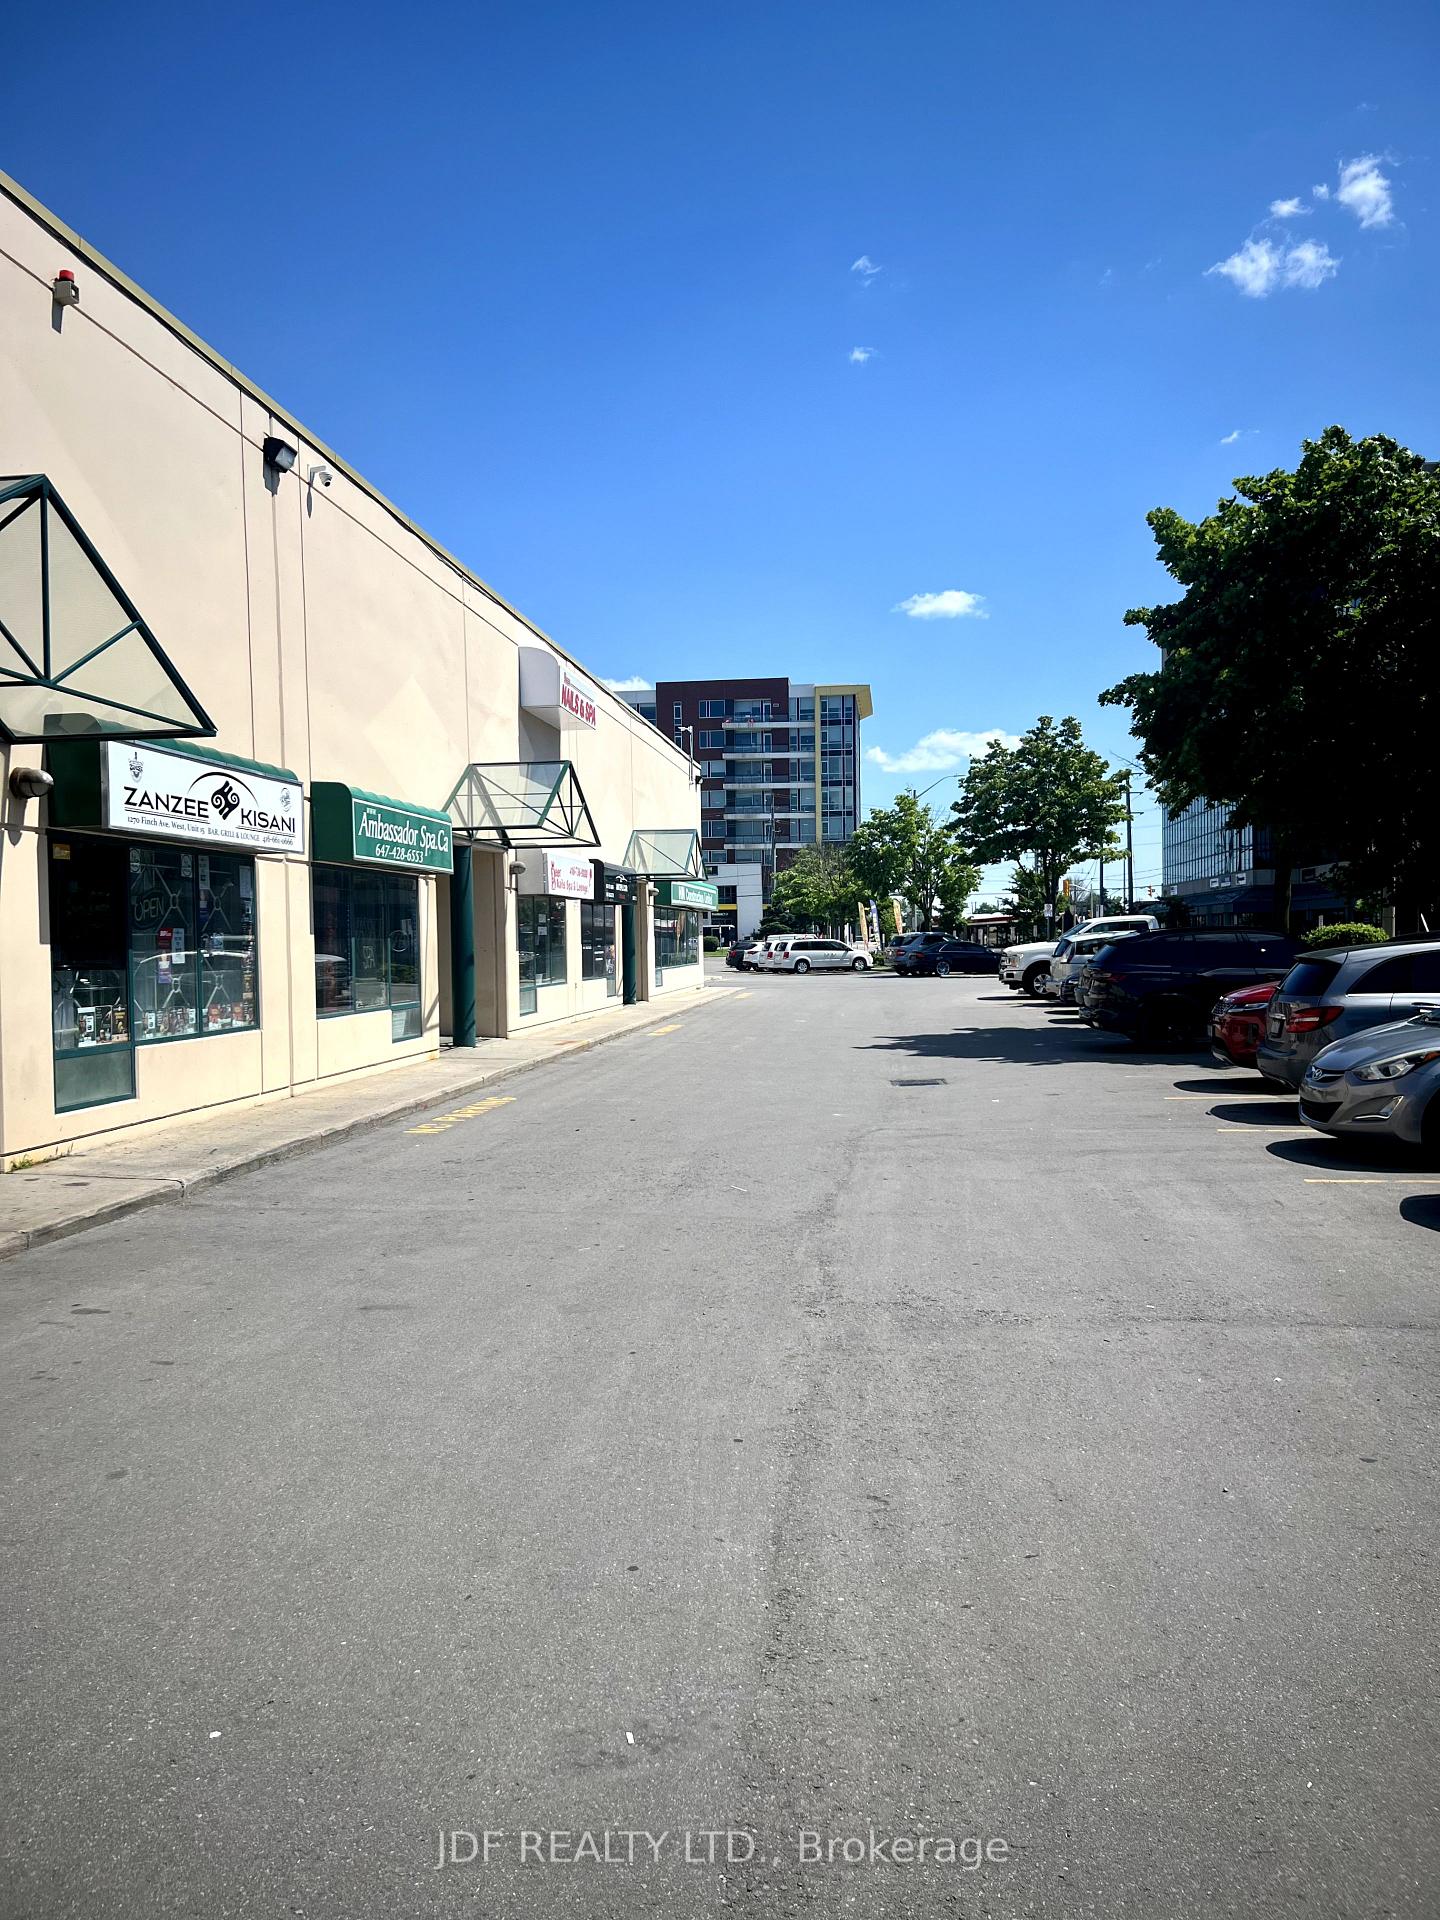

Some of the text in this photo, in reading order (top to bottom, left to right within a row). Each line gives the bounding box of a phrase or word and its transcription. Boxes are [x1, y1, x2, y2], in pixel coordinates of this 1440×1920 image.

[561, 683, 579, 715] NAILS
[585, 701, 596, 726] SPA
[124, 786, 295, 833] ZANZEE KISANI
[127, 816, 140, 824] 1270
[141, 816, 158, 826] Finch
[159, 820, 170, 828] Ave.
[187, 823, 199, 832] Unit
[358, 811, 449, 857] Ambassador Spa.Ca
[375, 843, 424, 863] 647-428-6553
[133, 897, 165, 922] OPEN
